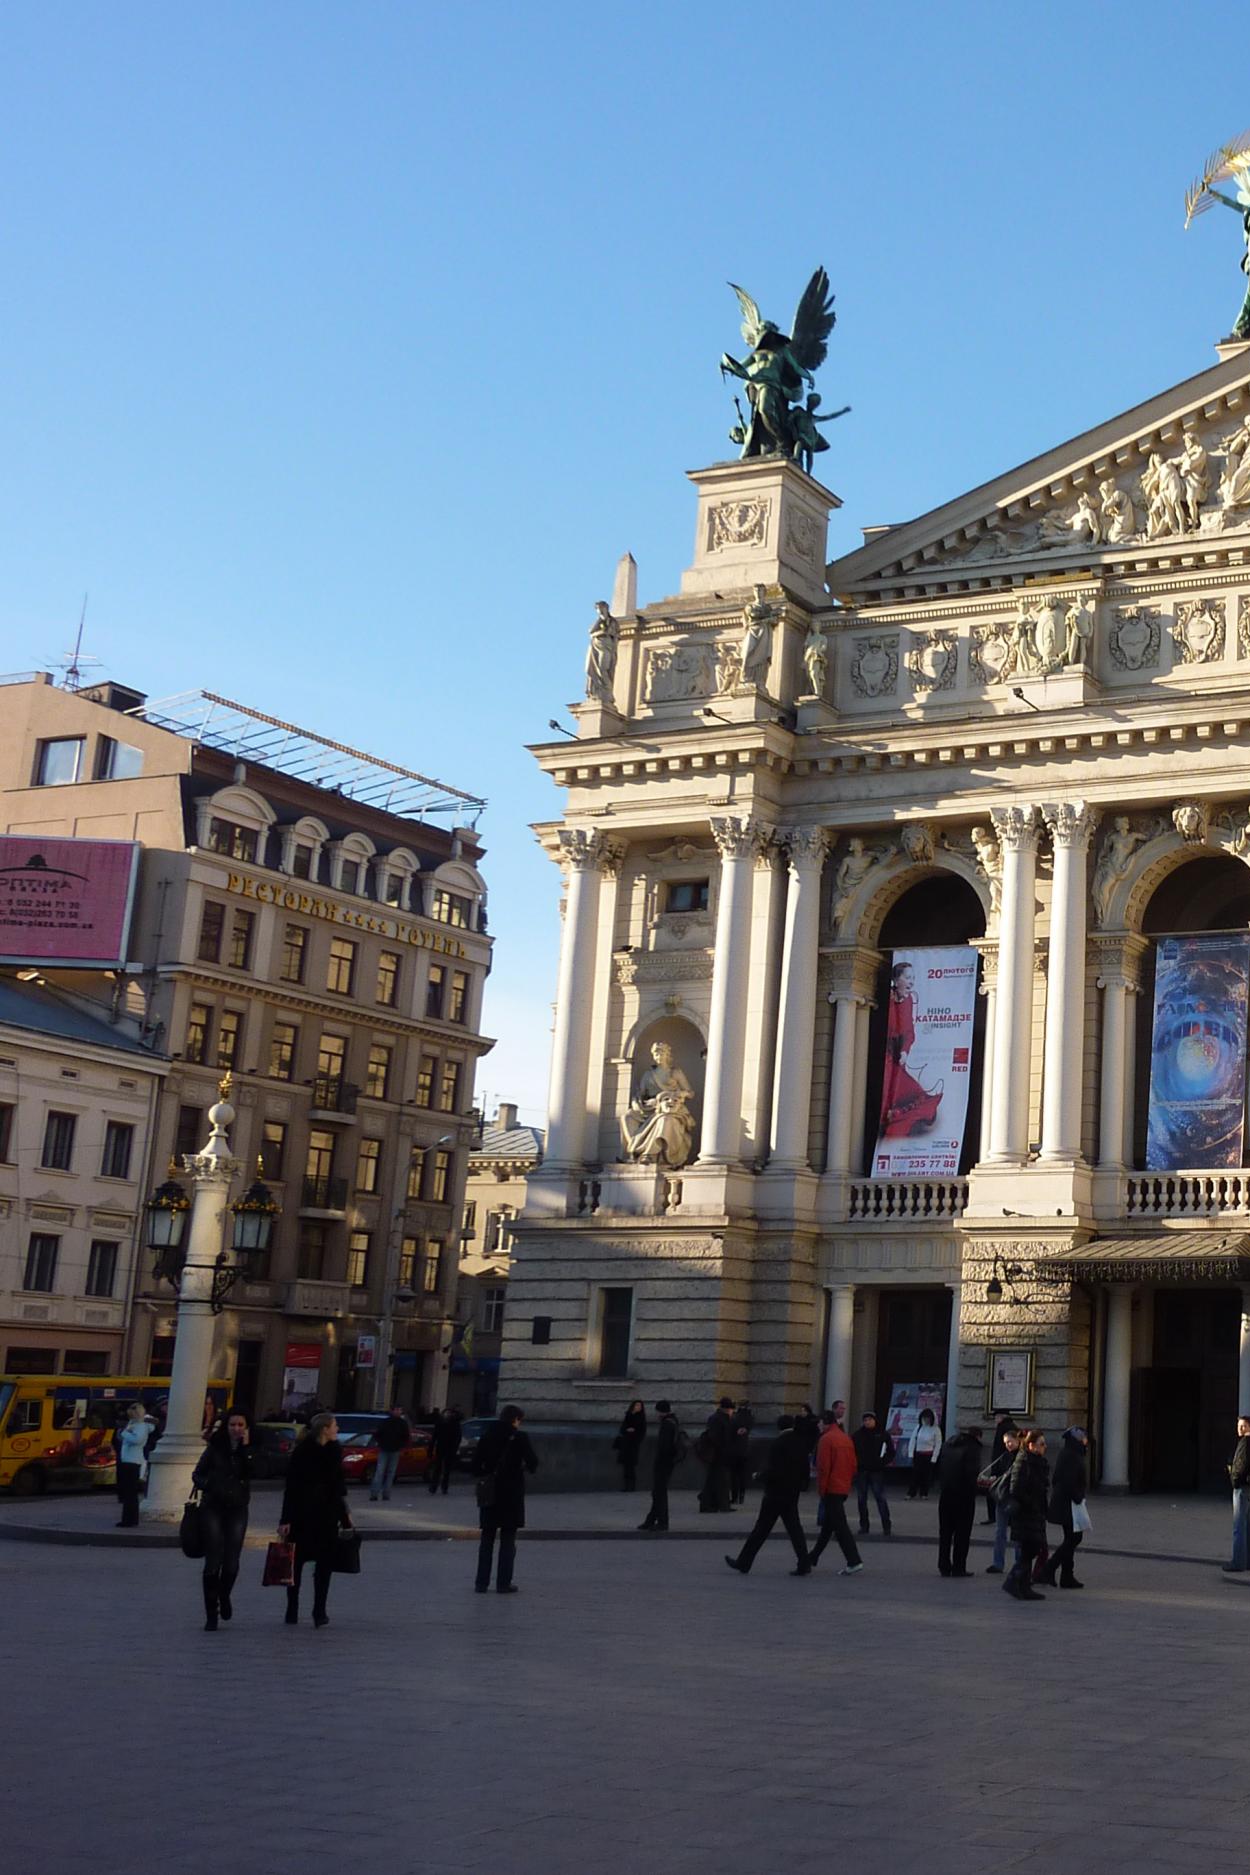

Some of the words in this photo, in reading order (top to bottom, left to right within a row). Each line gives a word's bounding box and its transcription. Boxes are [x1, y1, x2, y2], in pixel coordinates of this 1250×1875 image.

[227, 872, 341, 922] РЕСТОРАН
[395, 922, 466, 957] ГОТЕЛЬ
[928, 969, 943, 979] 20
[915, 1014, 972, 1023] КАТАМАДЗЕ
[909, 1160, 926, 1168] 235
[929, 1160, 940, 1168] 77
[944, 1160, 956, 1168] 88
